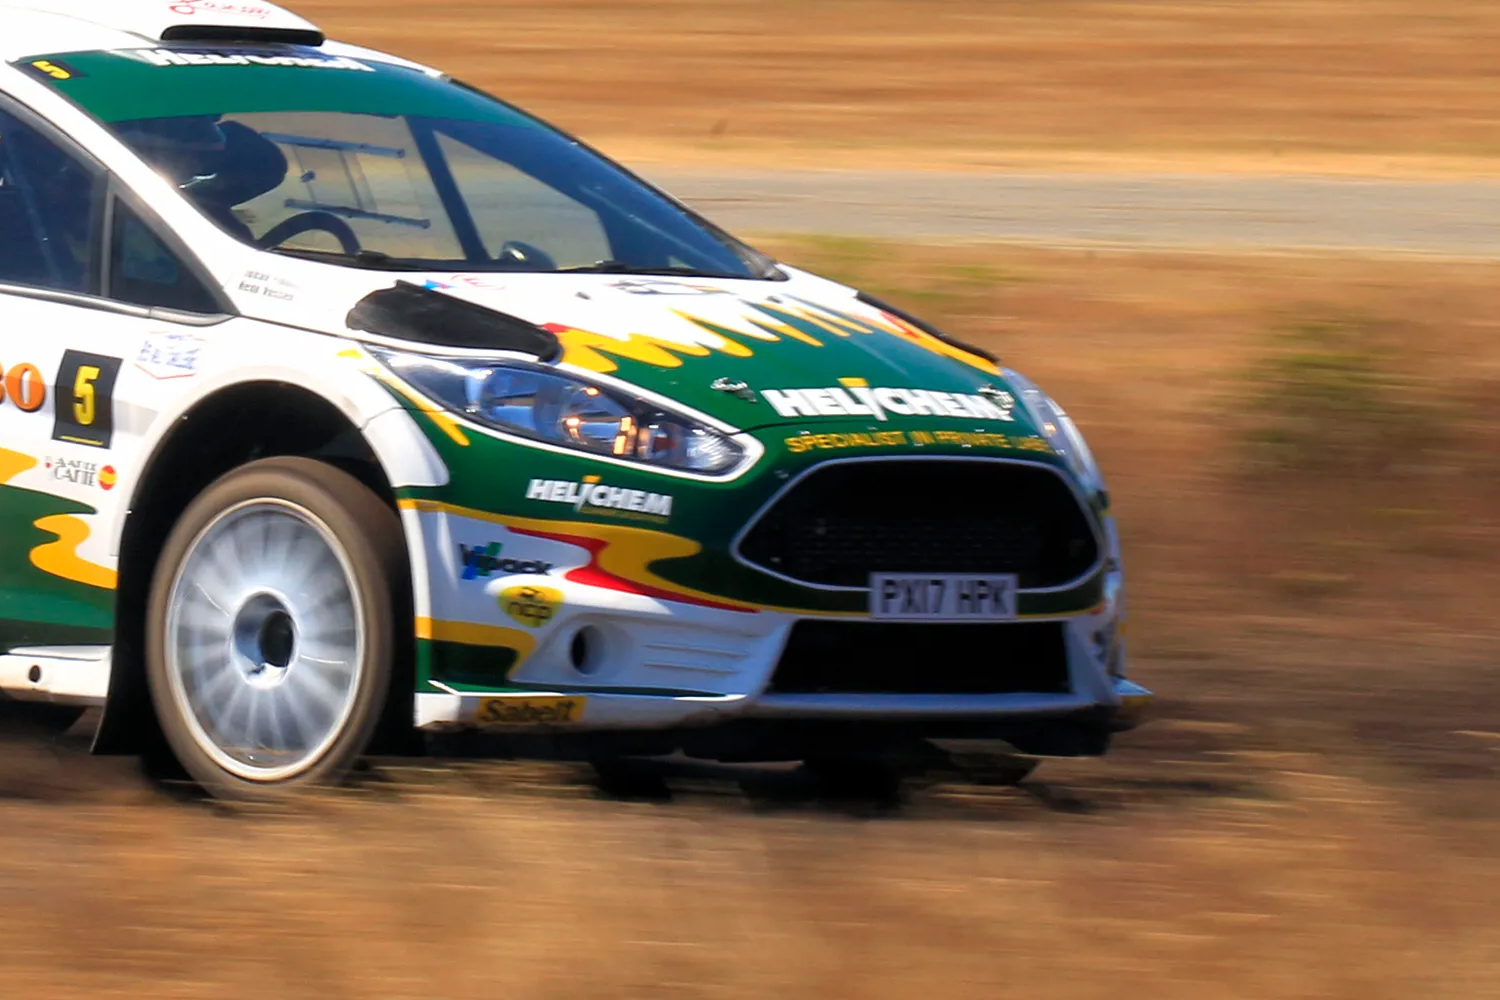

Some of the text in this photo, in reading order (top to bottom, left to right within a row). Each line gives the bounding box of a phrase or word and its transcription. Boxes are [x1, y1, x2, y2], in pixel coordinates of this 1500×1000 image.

[31, 60, 71, 80] 5
[73, 366, 101, 426] 5
[784, 430, 906, 453] SPECIALIST
[525, 475, 673, 517] HELICHEM
[881, 579, 1009, 614] PX17 HPK
